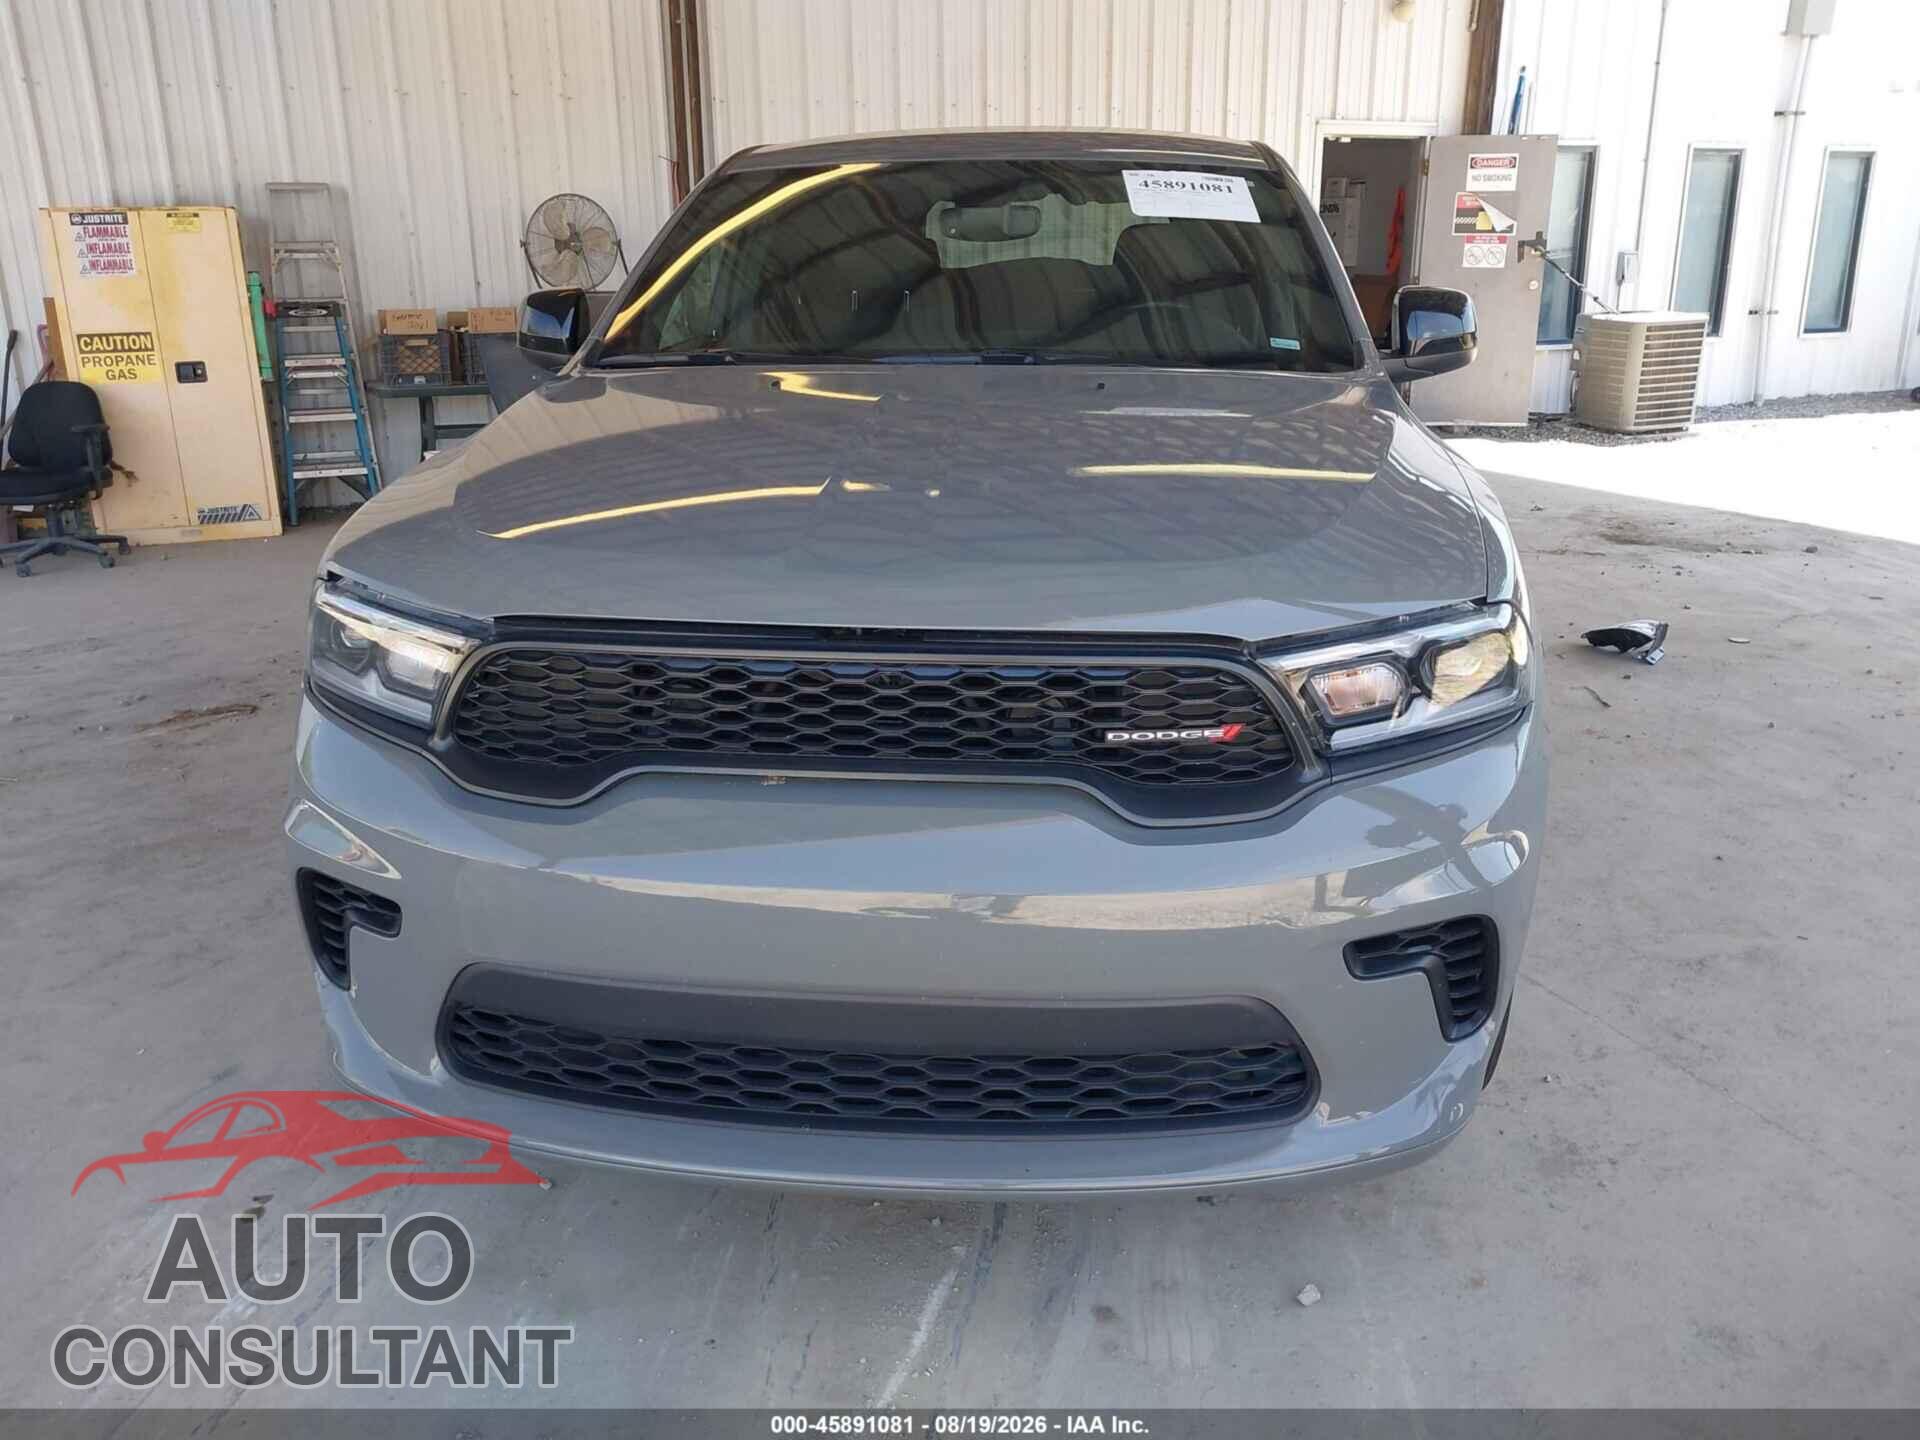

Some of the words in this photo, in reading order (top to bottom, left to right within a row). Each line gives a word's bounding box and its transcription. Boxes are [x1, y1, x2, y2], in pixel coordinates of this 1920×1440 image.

[1477, 158, 1510, 167] DANGER
[1138, 179, 1234, 194] 45891081
[83, 214, 125, 224] JUSTRITE
[83, 226, 128, 239] FLAMMABLE
[86, 242, 131, 255] INFLAMABLE
[88, 258, 134, 271] INFLAMMABLE
[80, 334, 152, 351] CAUTION
[81, 354, 157, 369] PROPANE
[105, 368, 138, 381] GAS
[1107, 729, 1225, 741] DODGE
